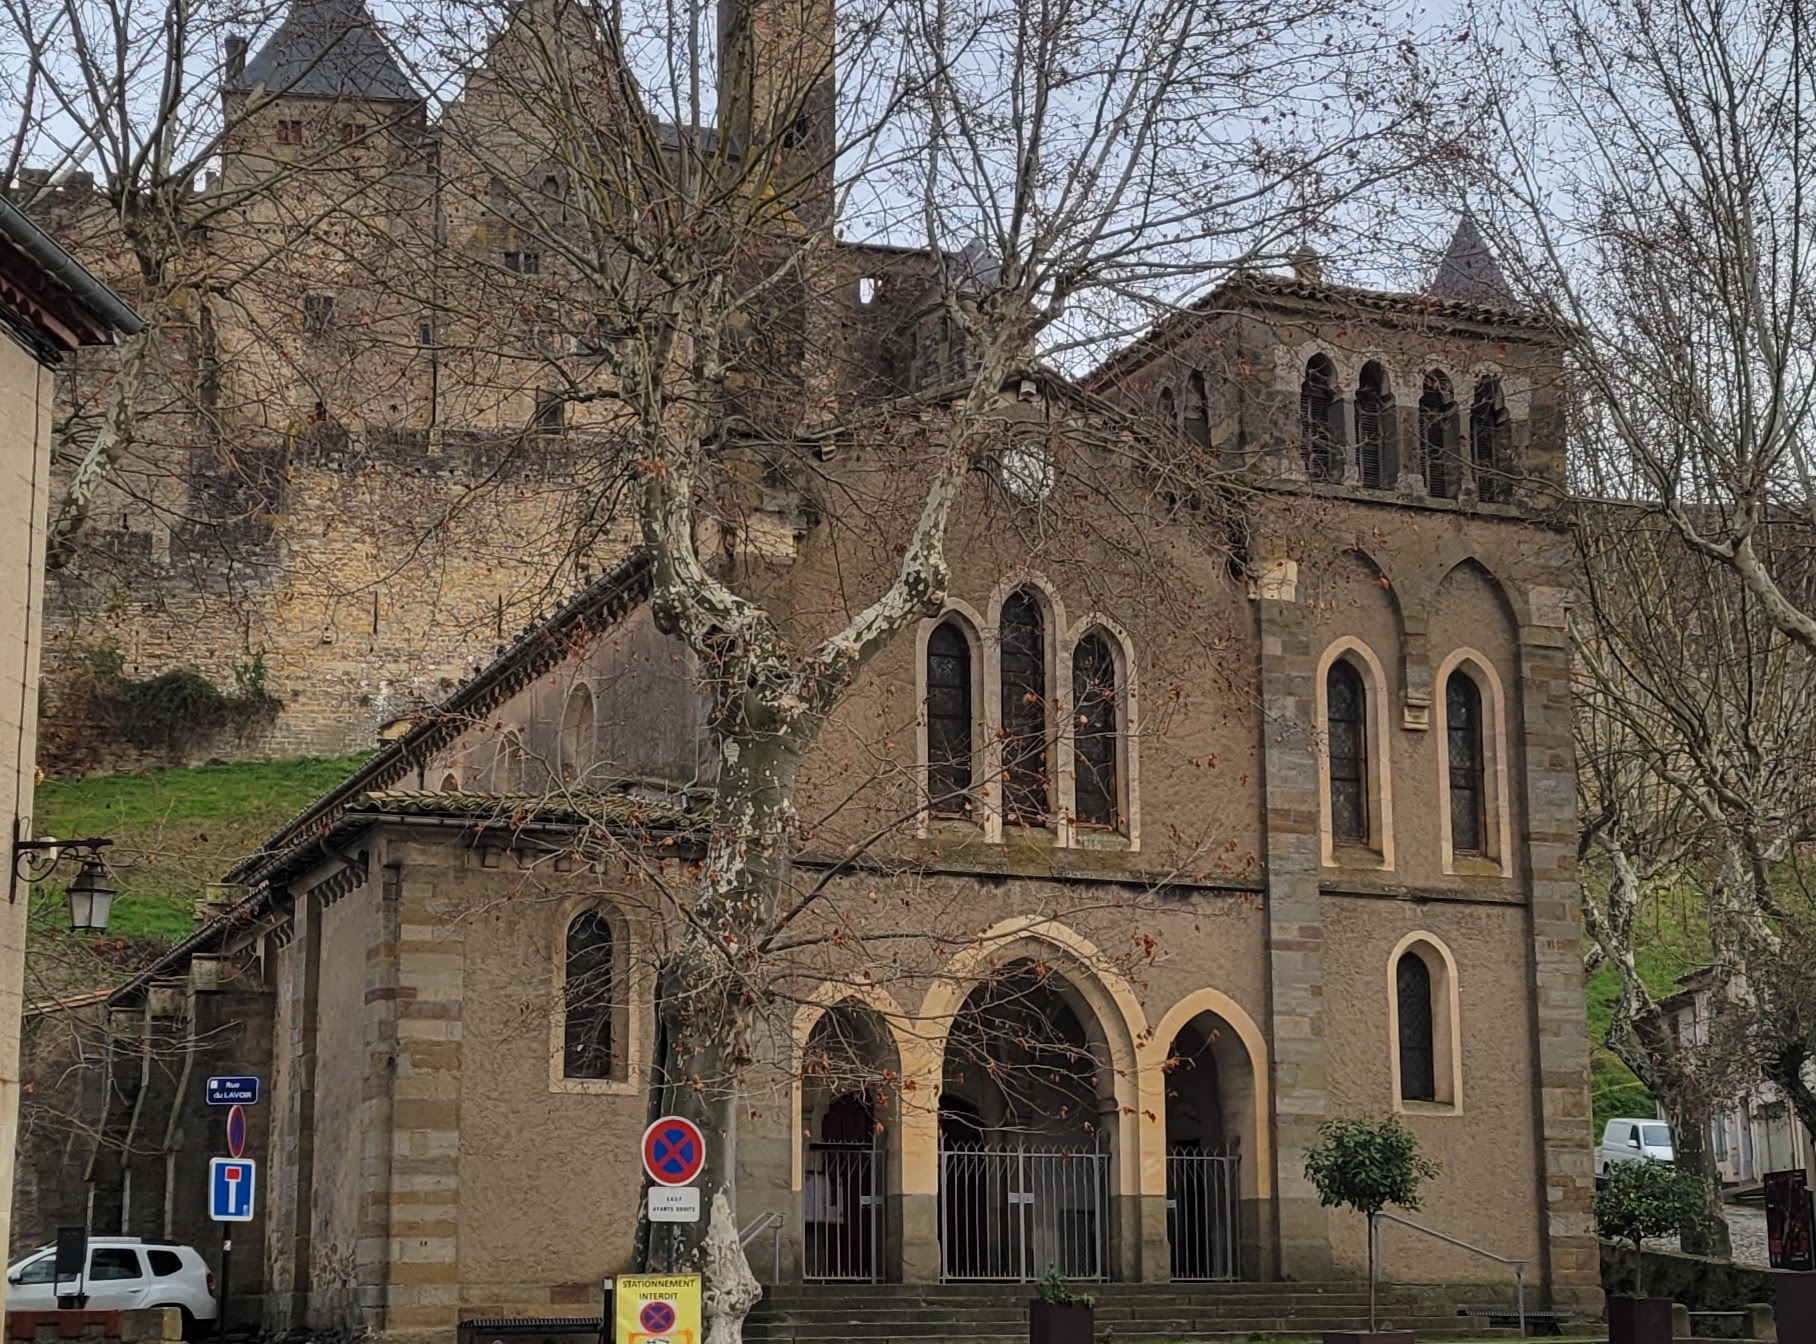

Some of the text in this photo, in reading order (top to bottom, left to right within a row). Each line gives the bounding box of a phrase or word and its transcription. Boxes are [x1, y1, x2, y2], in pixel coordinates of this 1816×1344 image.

[225, 1081, 240, 1089] Rue
[224, 1091, 252, 1099] LAVOIR
[622, 1279, 695, 1288] STATIONNEMENT
[639, 1292, 678, 1300] INTERDIT
